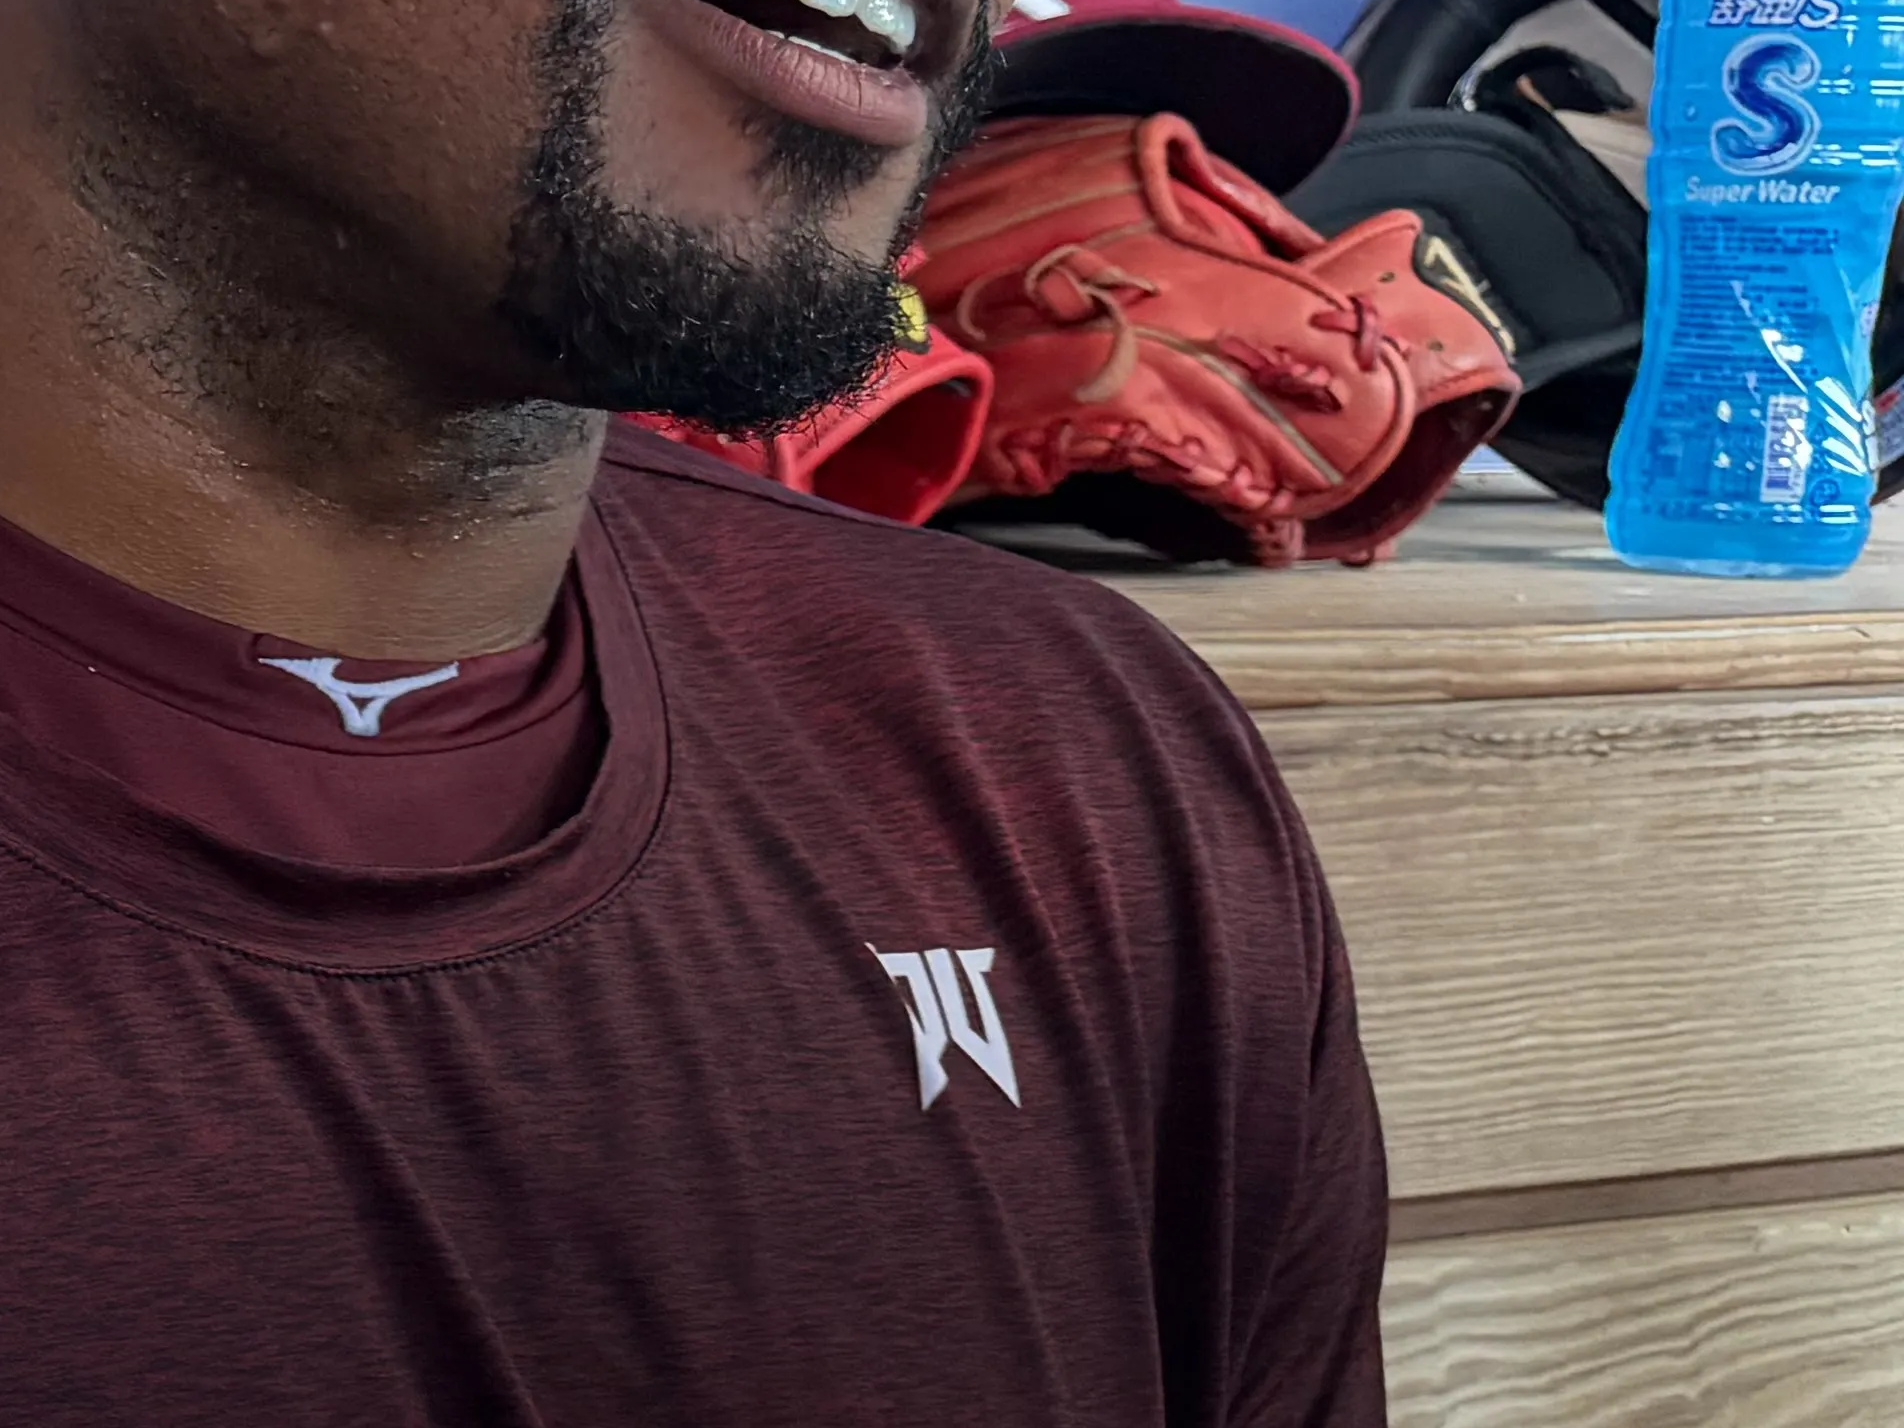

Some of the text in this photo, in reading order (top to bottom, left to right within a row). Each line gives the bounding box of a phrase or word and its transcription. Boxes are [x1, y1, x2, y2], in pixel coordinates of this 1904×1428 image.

[1710, 33, 1821, 176] S
[1685, 176, 1841, 207] Super Water
